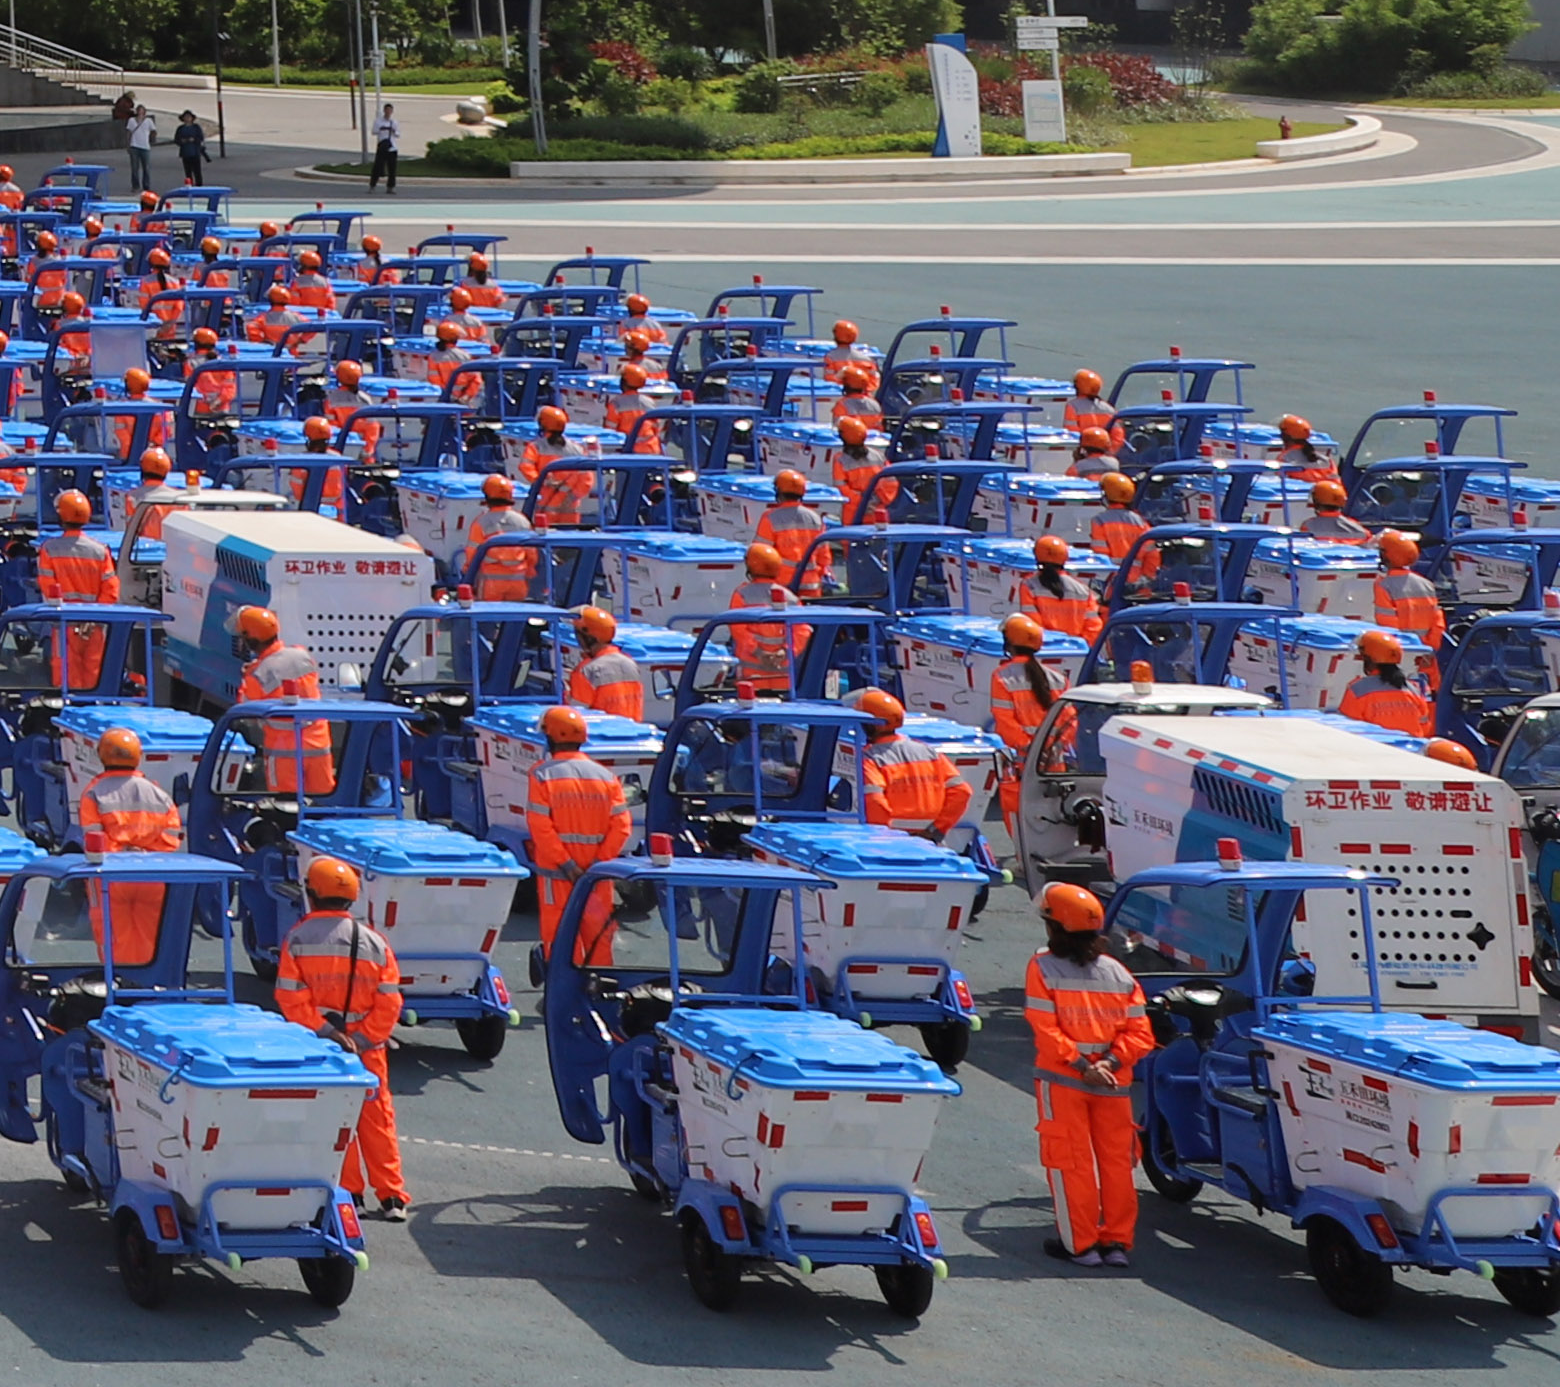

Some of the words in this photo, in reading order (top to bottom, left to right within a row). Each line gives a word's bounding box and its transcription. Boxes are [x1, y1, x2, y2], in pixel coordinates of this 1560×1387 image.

[285, 560, 346, 576] 环卫作业
[355, 560, 417, 577] 敬请避让
[1304, 790, 1393, 810] 环卫作业
[1404, 790, 1495, 813] 敬请避让
